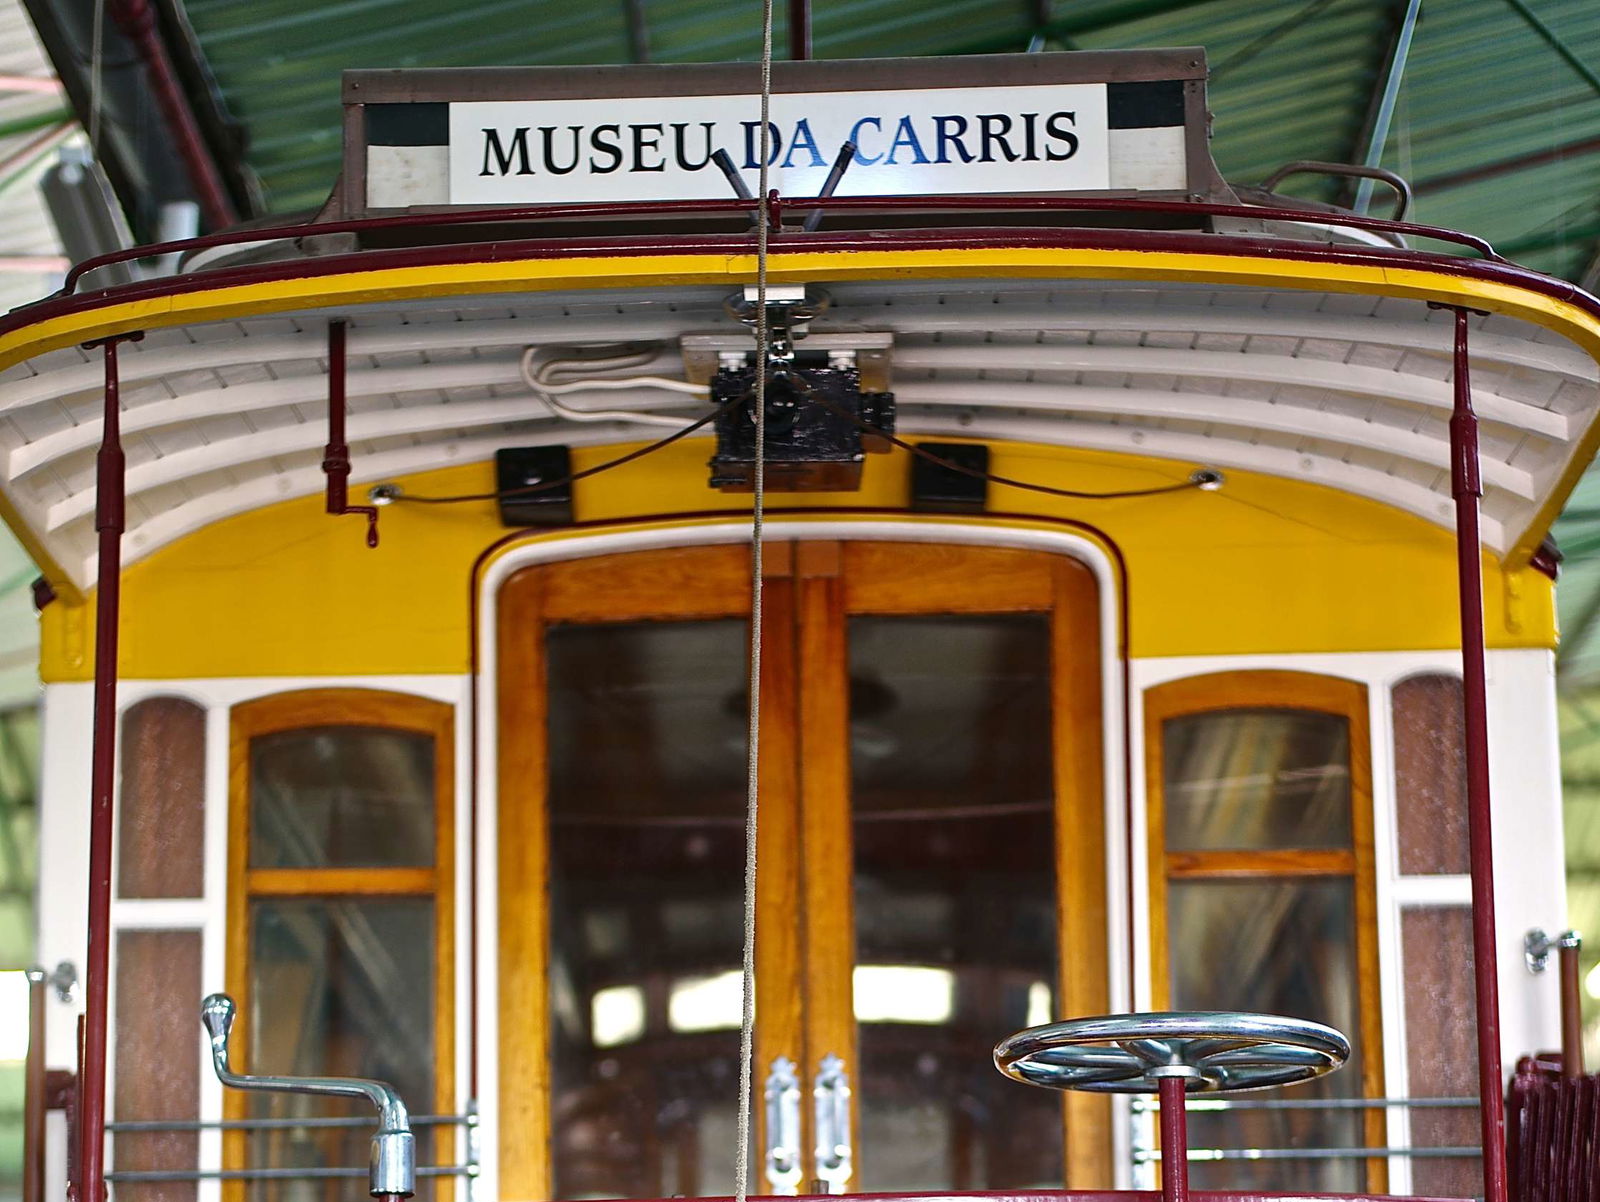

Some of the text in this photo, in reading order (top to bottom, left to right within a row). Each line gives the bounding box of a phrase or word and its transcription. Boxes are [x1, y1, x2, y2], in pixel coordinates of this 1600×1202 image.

[479, 111, 1080, 176] MUSEU DA CARRIS
